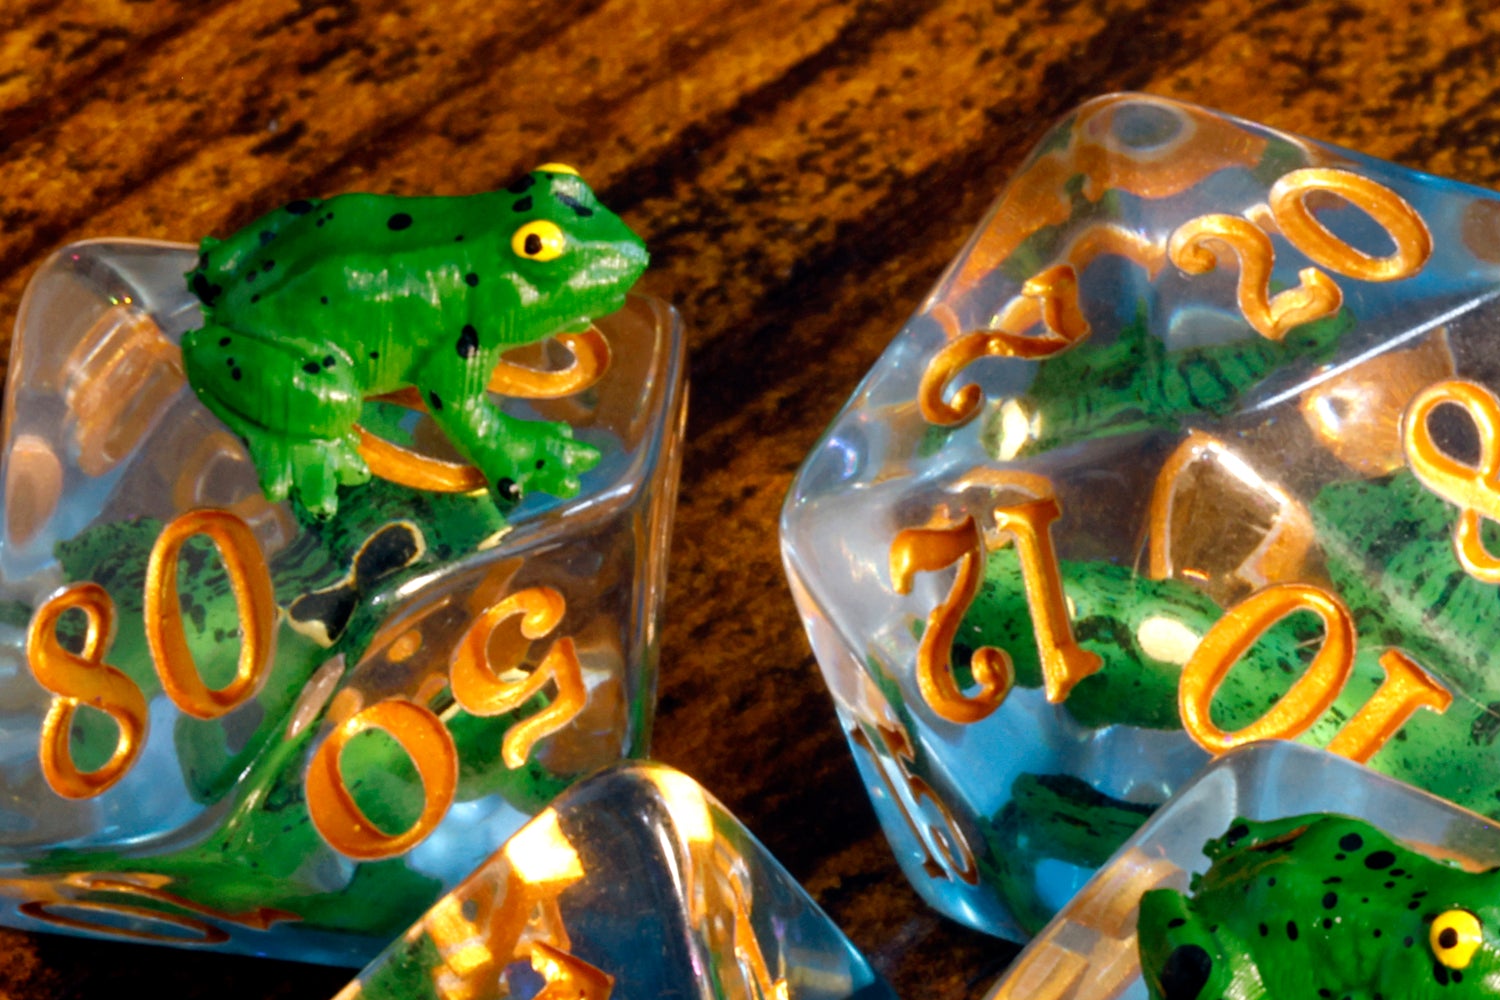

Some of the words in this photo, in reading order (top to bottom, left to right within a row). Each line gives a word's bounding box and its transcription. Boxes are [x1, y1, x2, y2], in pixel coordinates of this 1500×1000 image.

[1167, 166, 1433, 340] 20
[26, 508, 276, 800] 80
[889, 496, 1104, 725] 12
